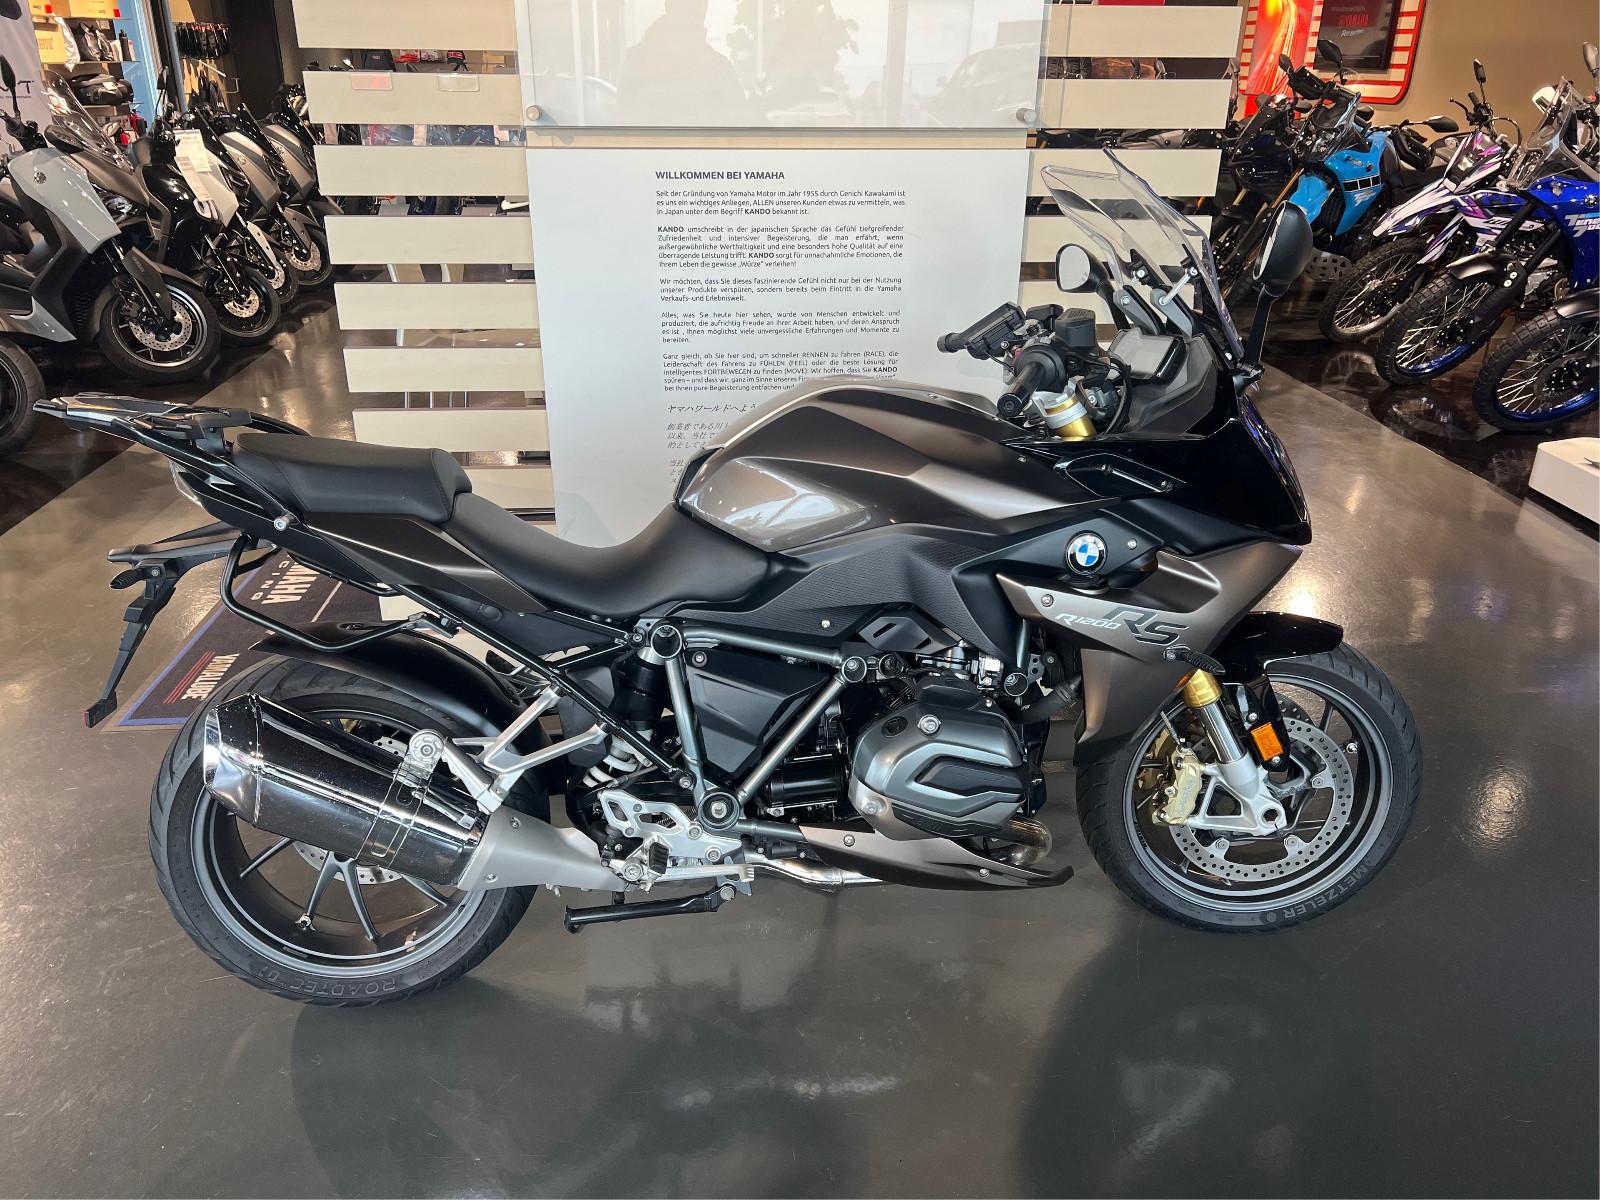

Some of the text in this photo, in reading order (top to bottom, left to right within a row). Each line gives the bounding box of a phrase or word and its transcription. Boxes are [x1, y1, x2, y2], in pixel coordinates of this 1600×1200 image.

[682, 190, 715, 198] Gründung
[689, 199, 720, 208] wichtiges
[721, 199, 751, 208] Anliegen,
[664, 208, 684, 216] Japan
[720, 208, 743, 216] Begriff
[261, 562, 320, 605] MAHA
[1103, 606, 1190, 647] RS
[181, 653, 241, 701] YAMALUBE
[1283, 866, 1369, 919] METZELER
[289, 978, 397, 996] ROADTEC
